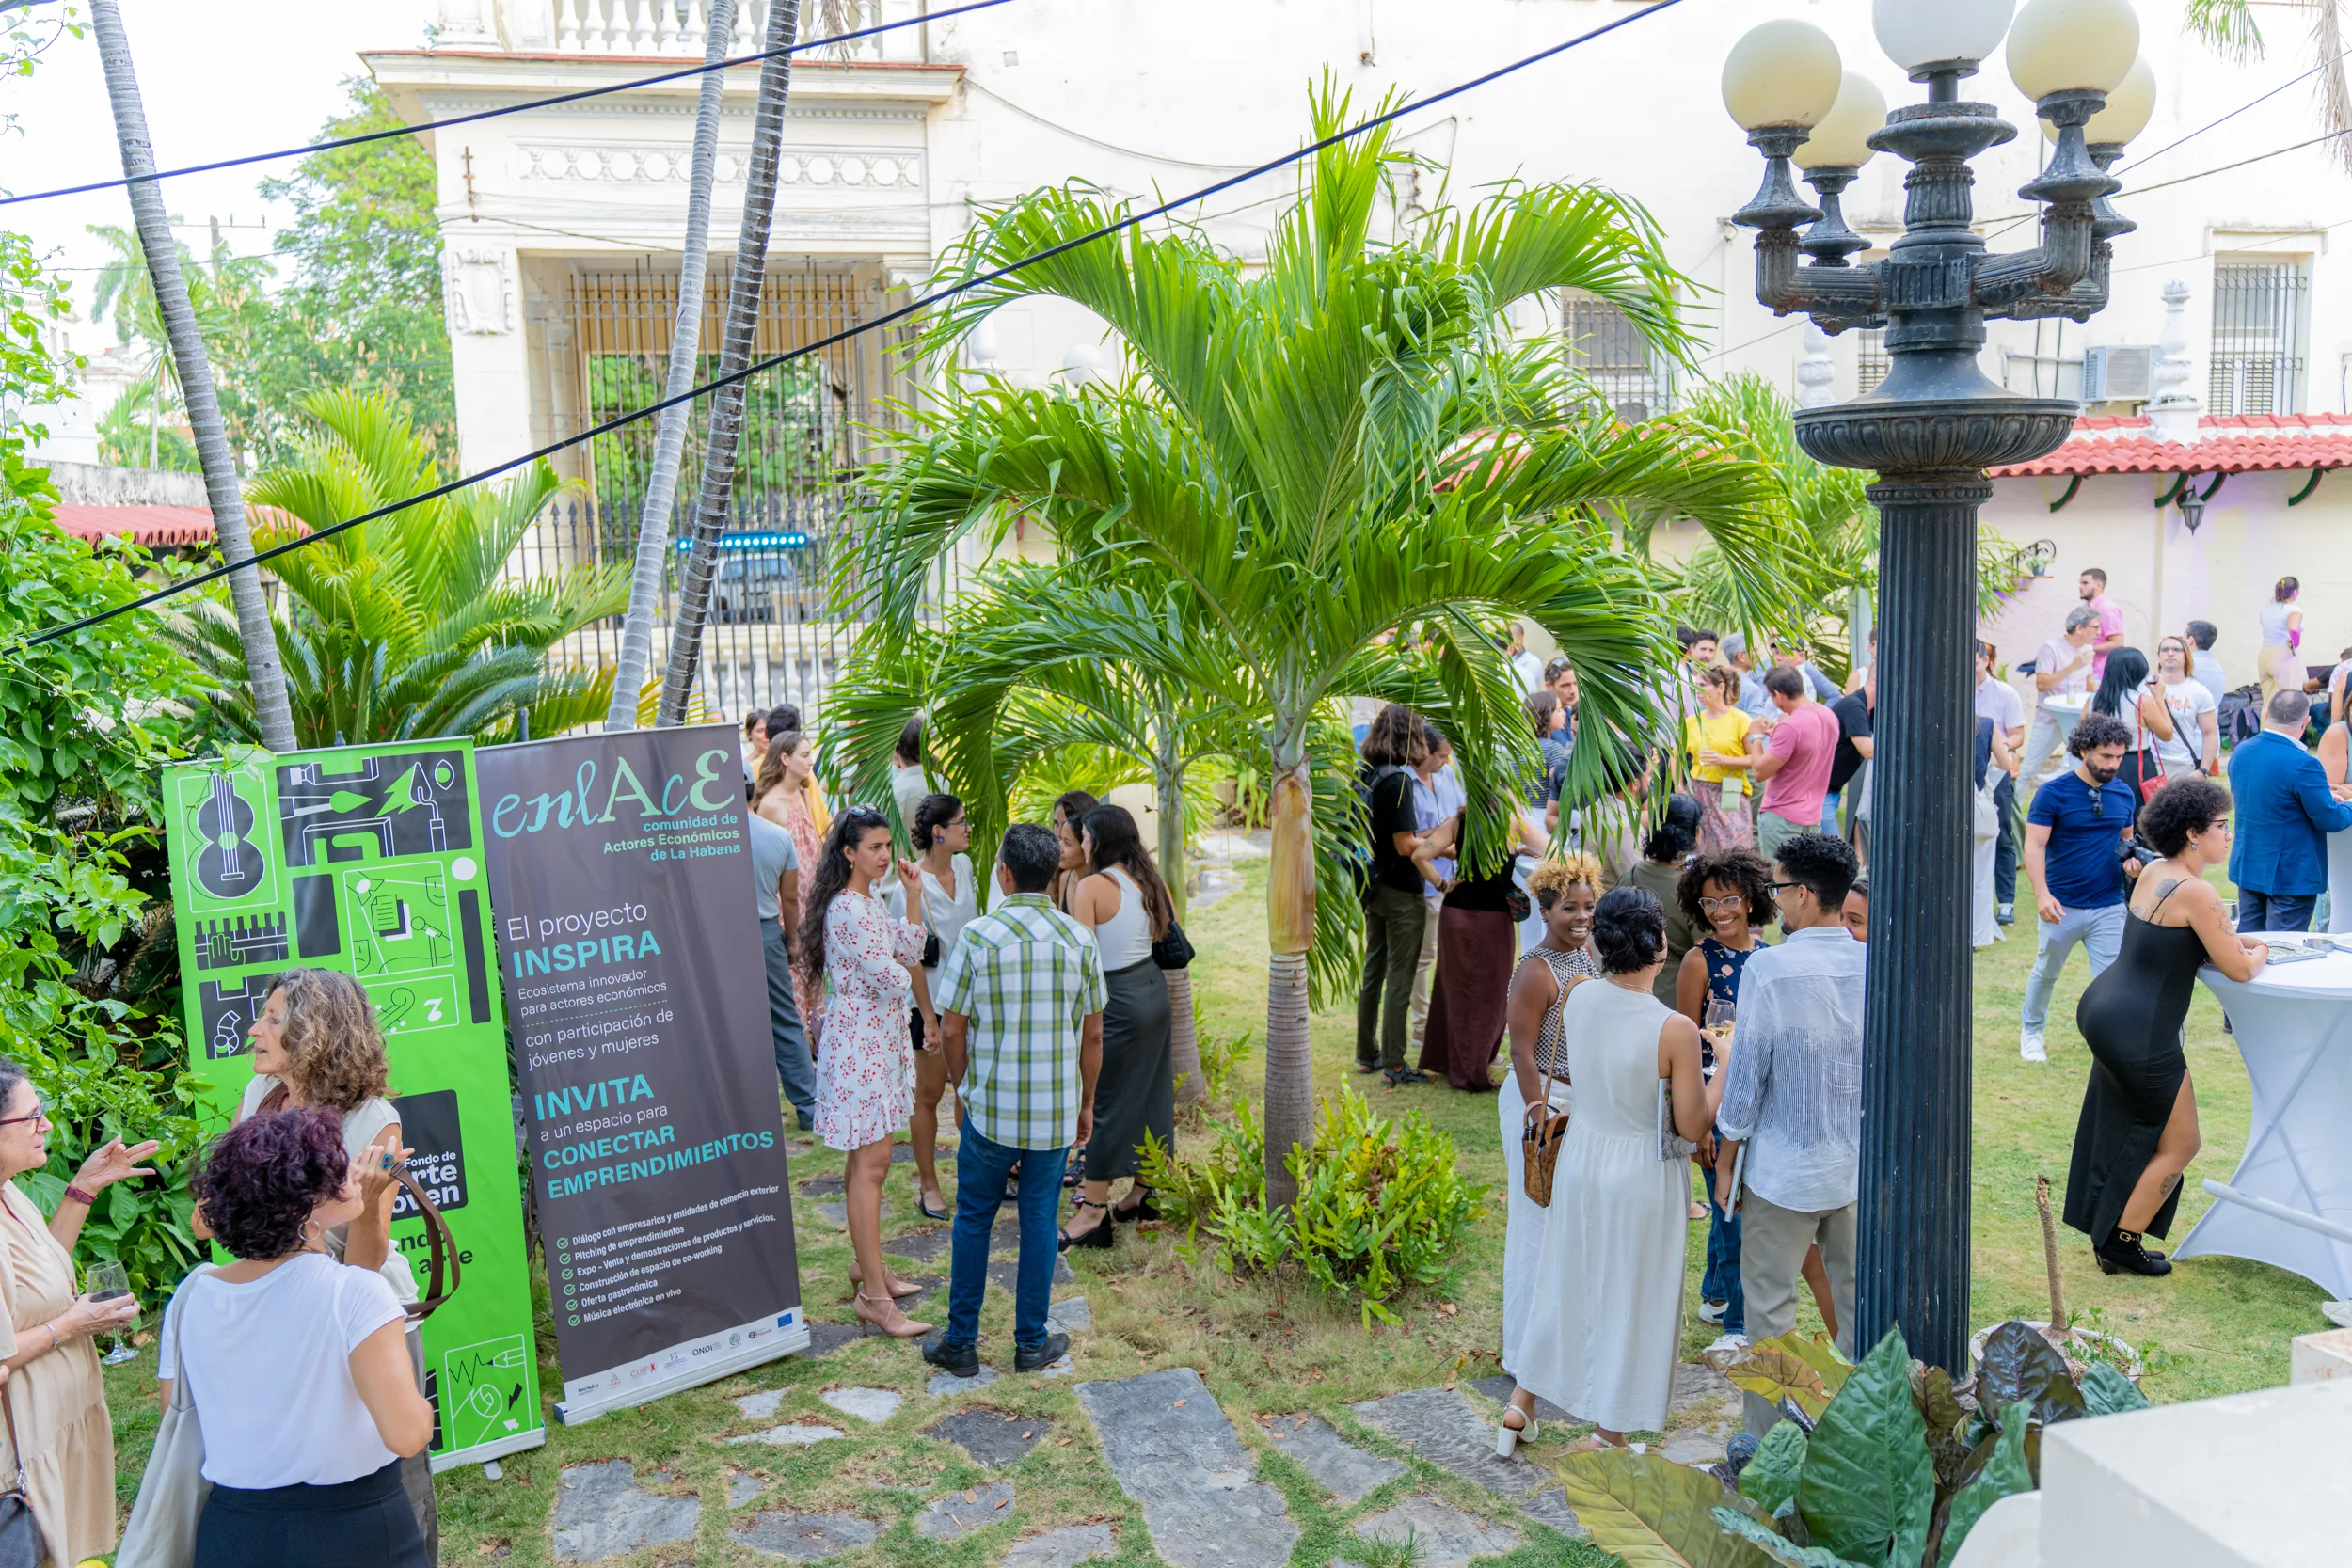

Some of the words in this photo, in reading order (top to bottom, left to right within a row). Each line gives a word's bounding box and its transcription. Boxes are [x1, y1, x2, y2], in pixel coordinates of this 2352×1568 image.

[603, 838, 655, 854] Actores
[659, 830, 739, 846] Económicos
[643, 816, 718, 832] comunidad
[721, 813, 738, 826] de
[650, 848, 667, 862] de
[670, 847, 686, 860] La
[690, 843, 740, 858] Habana
[507, 915, 529, 941] El
[539, 902, 647, 942] proyecto
[513, 929, 661, 978] INSPIRA
[517, 978, 586, 1000] Ecosistema
[589, 968, 647, 988] innovador
[520, 1001, 548, 1019] para
[549, 995, 595, 1011] actores
[596, 981, 667, 1004] económicos
[525, 1032, 553, 1048] con
[557, 1014, 655, 1046] participación
[656, 1008, 674, 1024] de
[528, 1046, 584, 1072] jóvenes
[588, 1043, 597, 1059] y
[602, 1032, 660, 1058] mujeres
[534, 1074, 654, 1120] INVITA
[541, 1130, 549, 1142] a
[553, 1123, 572, 1139] un
[576, 1113, 632, 1136] espacio
[636, 1103, 668, 1125] para
[404, 1154, 439, 1168] Fondo
[441, 1151, 456, 1161] de
[543, 1125, 675, 1170] CONECTAR
[548, 1131, 774, 1199] EMPRENDIMIENTOS
[399, 1164, 458, 1190] rte
[572, 1231, 602, 1246] Diálogo
[602, 1227, 616, 1238] con
[617, 1215, 666, 1232] empresarios
[666, 1213, 672, 1224] y
[673, 1203, 708, 1220] entidades
[709, 1199, 719, 1210] de
[720, 1190, 749, 1207] comercio
[750, 1184, 780, 1196] exterior
[575, 1246, 607, 1261] Pitching
[607, 1243, 617, 1252] de
[617, 1226, 685, 1248] emprendimientos
[577, 1265, 597, 1277] Expo
[603, 1257, 624, 1270] Venta
[625, 1255, 630, 1264] y
[630, 1239, 691, 1261] demostraciones
[692, 1236, 702, 1245] de
[702, 1225, 739, 1243] productos
[739, 1223, 743, 1232] y
[743, 1213, 776, 1228] servicios.
[579, 1271, 628, 1292] Construcción
[629, 1268, 640, 1277] de
[641, 1261, 671, 1274] espacio
[672, 1258, 681, 1267] de
[682, 1244, 723, 1263] co-working
[580, 1294, 606, 1307] Oferta
[607, 1279, 659, 1302] gastronómica
[583, 1310, 612, 1323] Música
[612, 1295, 654, 1315] electrónica
[655, 1293, 665, 1302] en
[665, 1288, 682, 1298] vivo
